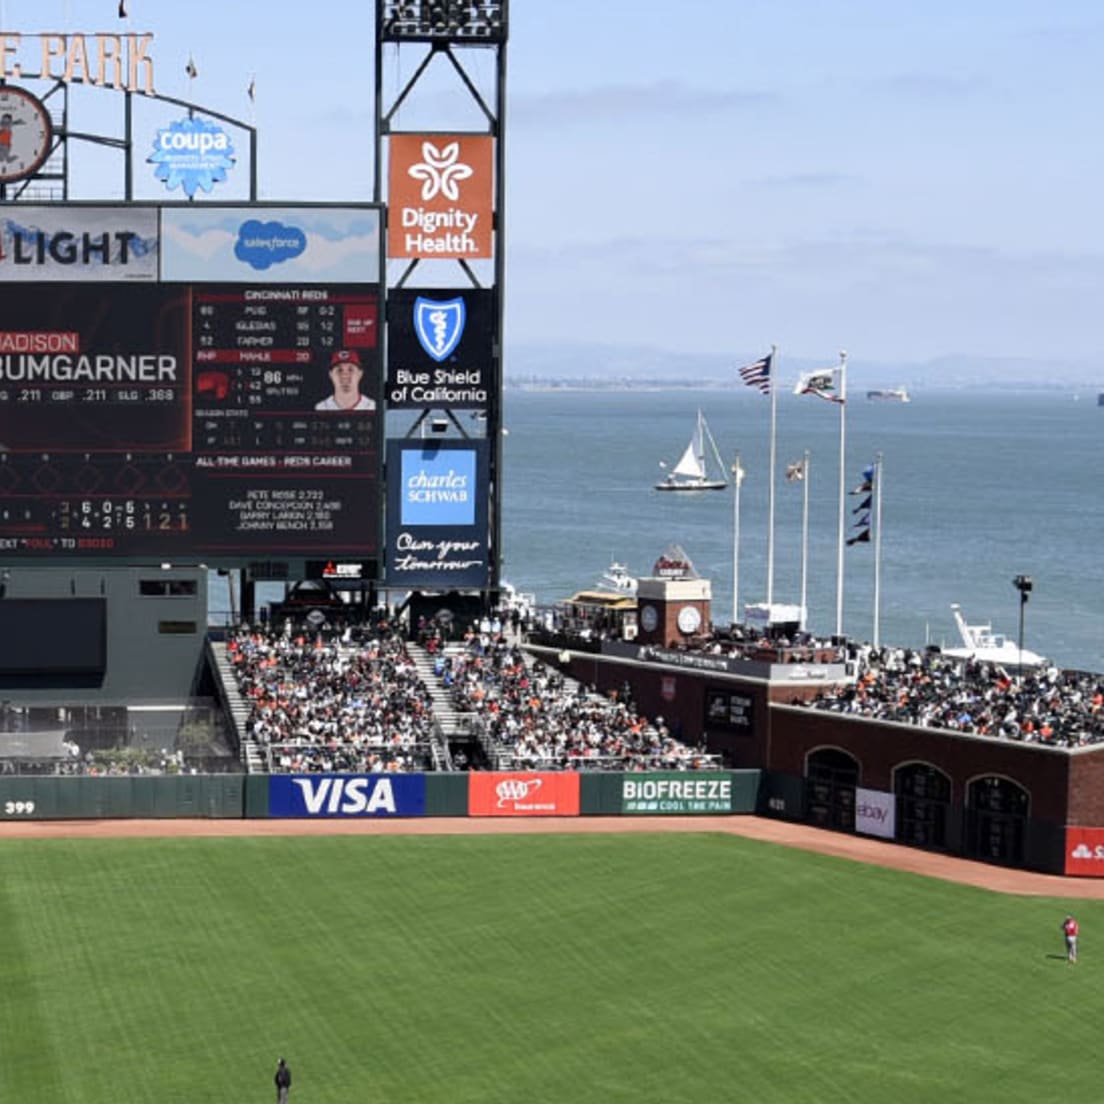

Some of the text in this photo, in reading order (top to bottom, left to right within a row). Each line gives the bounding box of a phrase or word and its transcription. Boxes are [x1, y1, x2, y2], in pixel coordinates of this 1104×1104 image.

[40, 32, 155, 97] PARK
[160, 132, 227, 154] coupa
[402, 208, 478, 233] Dignity
[13, 232, 135, 265] LIGHT
[244, 236, 299, 250] salesforce
[264, 371, 281, 384] 86
[396, 369, 481, 384] Blue Shield
[16, 389, 41, 401] .211
[82, 389, 106, 401] .211
[391, 386, 487, 402] of California
[407, 470, 467, 488] charles
[407, 490, 467, 503] SCHWAB
[396, 532, 480, 559] Own your
[394, 555, 483, 571] tomorrow
[292, 778, 396, 814] VISA
[4, 801, 35, 815] 399
[659, 801, 684, 810] COOL
[708, 801, 731, 810] PAIN
